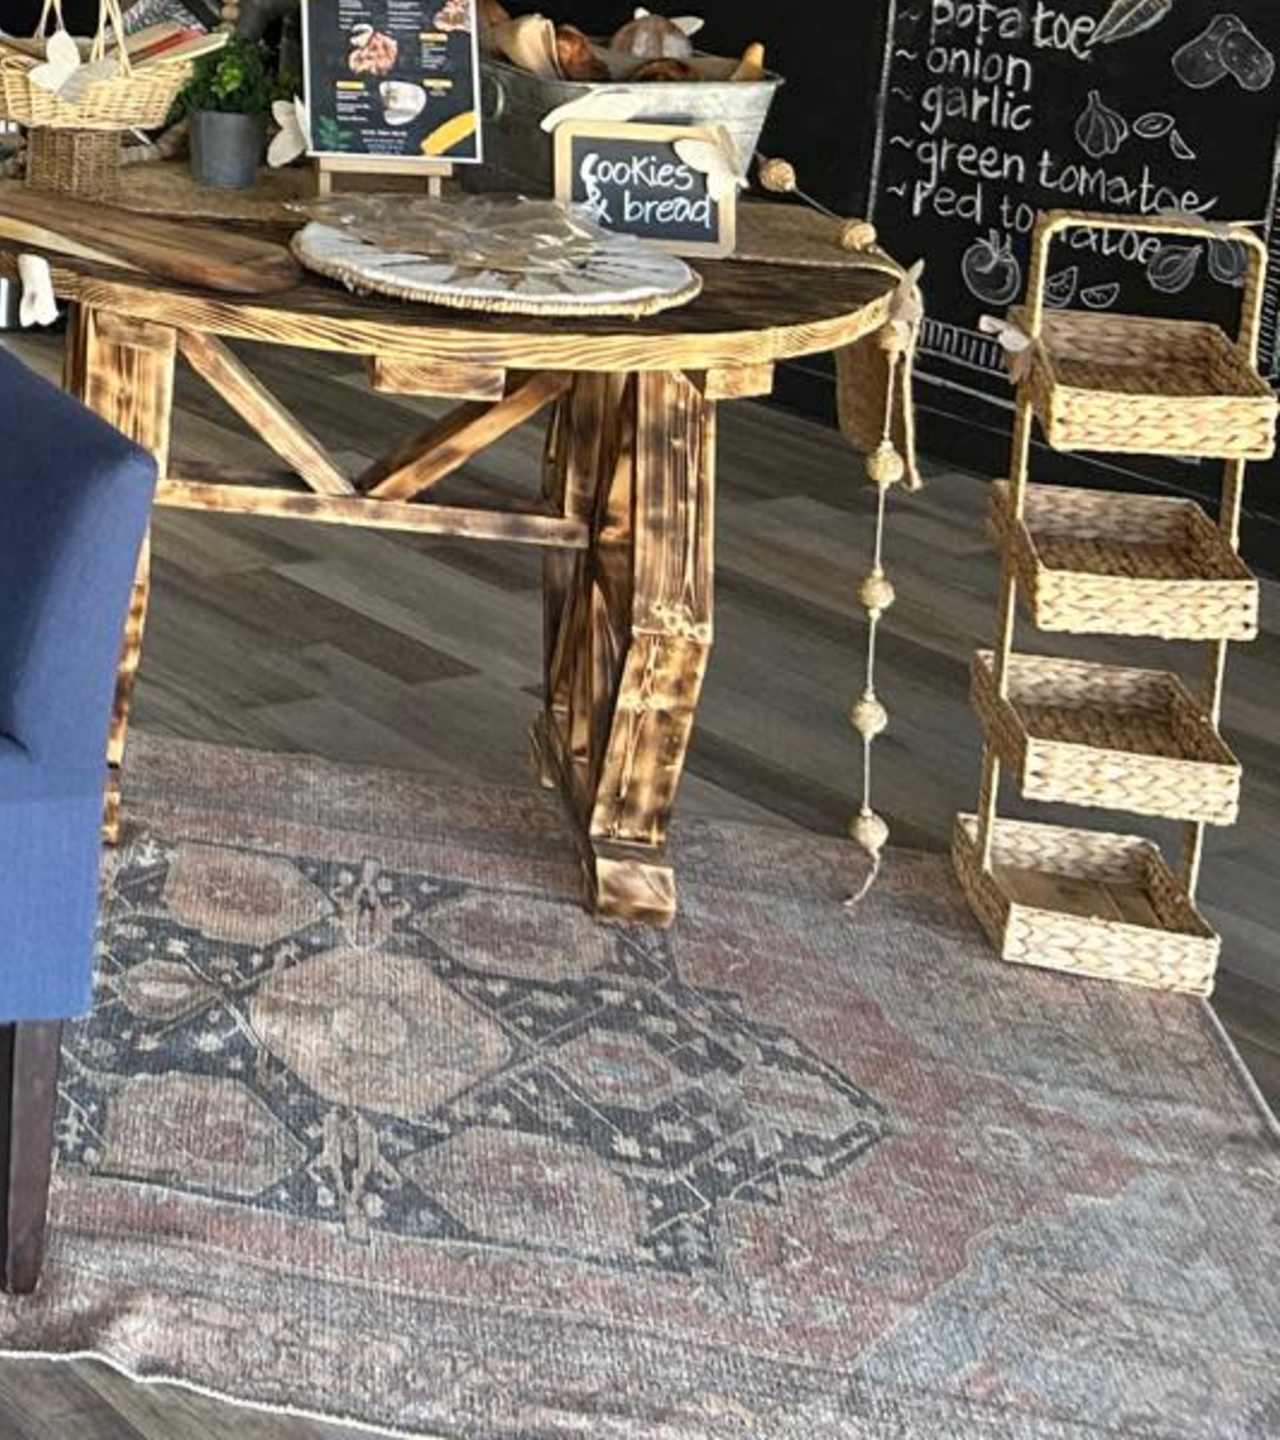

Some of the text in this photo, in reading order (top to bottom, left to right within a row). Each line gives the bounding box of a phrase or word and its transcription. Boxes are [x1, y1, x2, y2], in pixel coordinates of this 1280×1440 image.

[925, 36, 1033, 92] onion
[920, 86, 1034, 134] garlic
[915, 136, 1026, 189] green
[623, 190, 711, 230] bread
[913, 180, 983, 225] red
